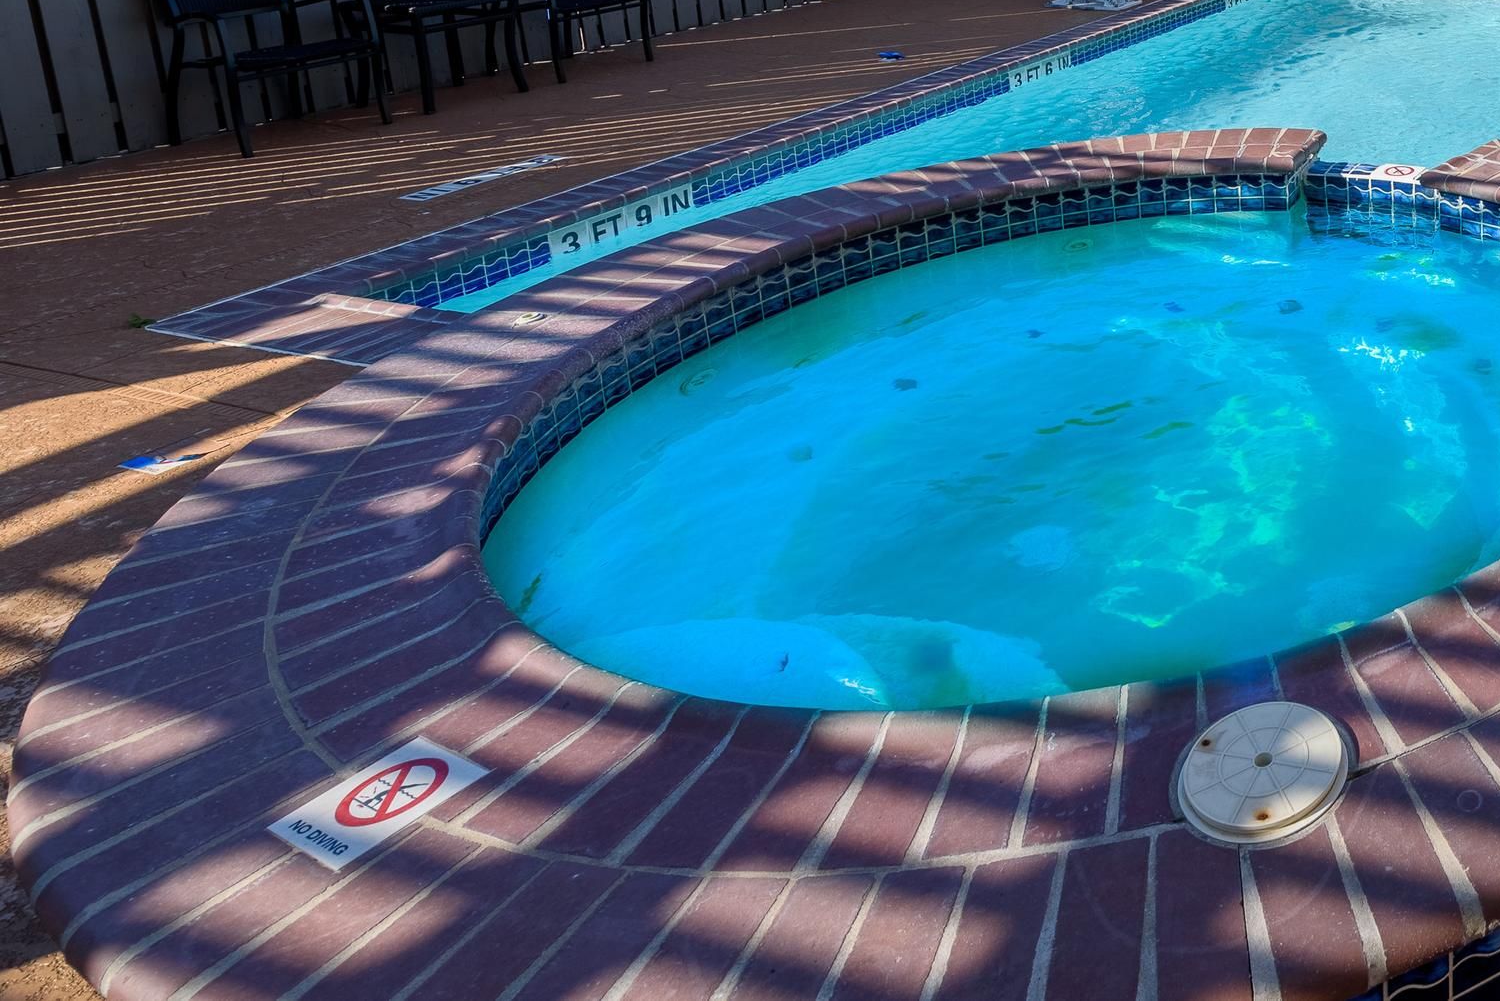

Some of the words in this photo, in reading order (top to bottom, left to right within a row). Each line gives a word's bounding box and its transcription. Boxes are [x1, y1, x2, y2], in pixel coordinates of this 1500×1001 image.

[1014, 72, 1022, 87] 3
[1027, 66, 1040, 82] FT
[1045, 61, 1053, 75] 6
[561, 231, 581, 254] 3
[592, 213, 622, 243] FT
[635, 204, 652, 227] 9
[663, 189, 691, 217] IN
[287, 819, 307, 835] NO
[305, 826, 350, 856] DIVING
